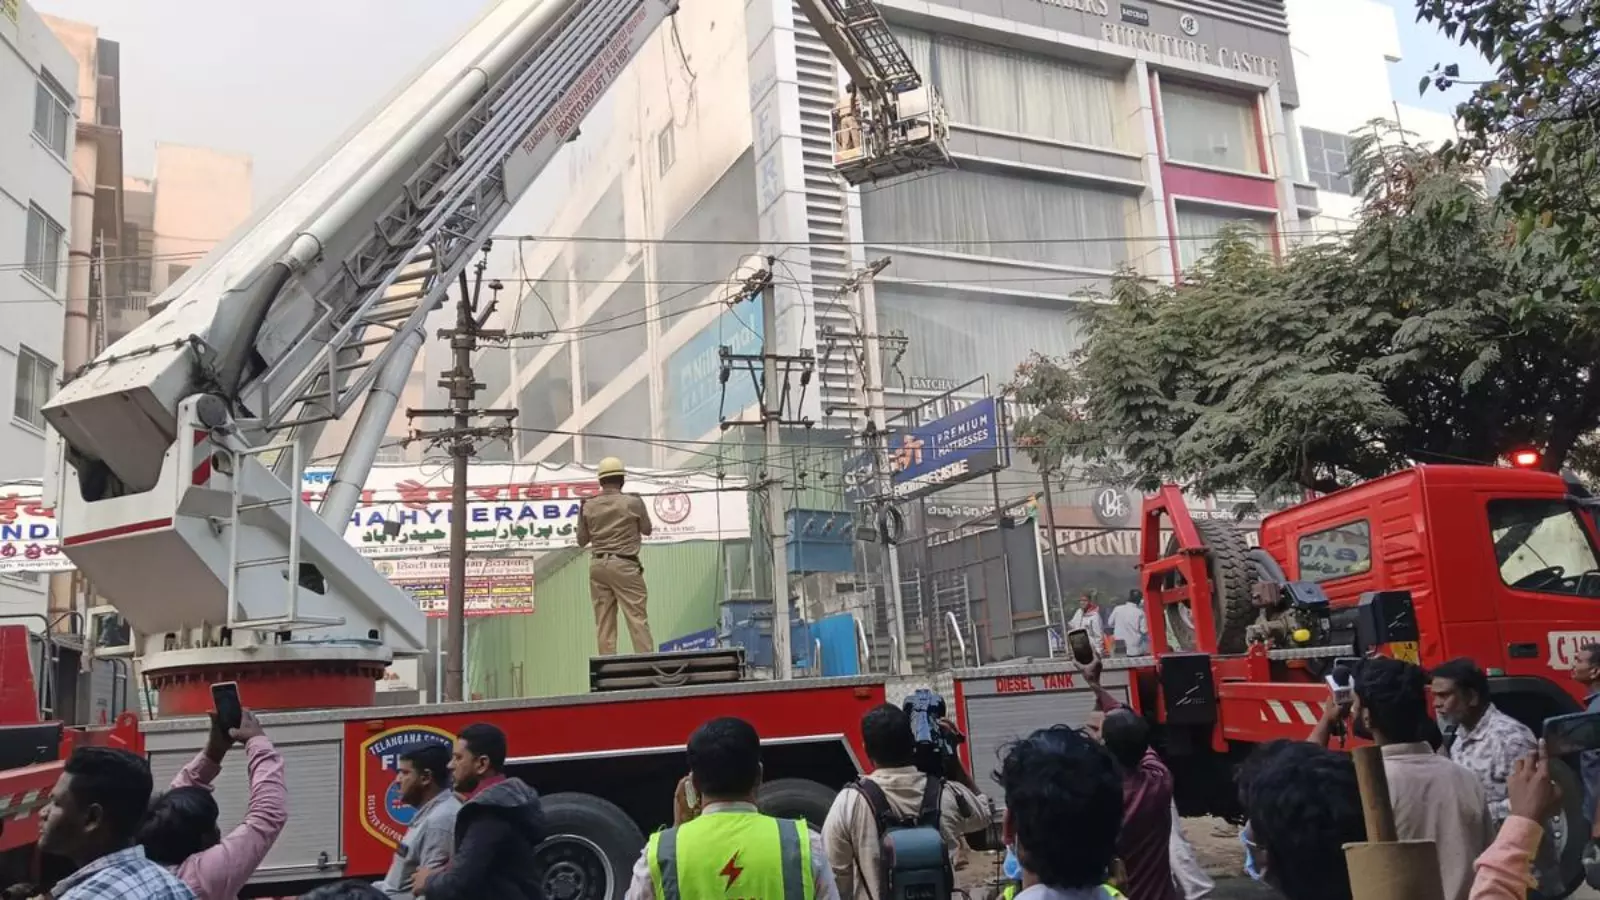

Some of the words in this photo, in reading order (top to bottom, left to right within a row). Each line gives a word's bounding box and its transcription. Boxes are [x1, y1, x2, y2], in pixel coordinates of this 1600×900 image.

[1100, 22, 1210, 64] FURNITURE
[1218, 47, 1280, 78] CASTLE
[556, 101, 585, 138] BRONTO
[581, 73, 607, 107] SKYLIFT
[936, 414, 988, 444] PREMIUM
[937, 429, 989, 458] MATTRESSES
[996, 675, 1035, 692] DIESEL
[1042, 672, 1074, 688] TANK
[368, 733, 422, 755] TELANGANA
[367, 795, 380, 827] DISASTER
